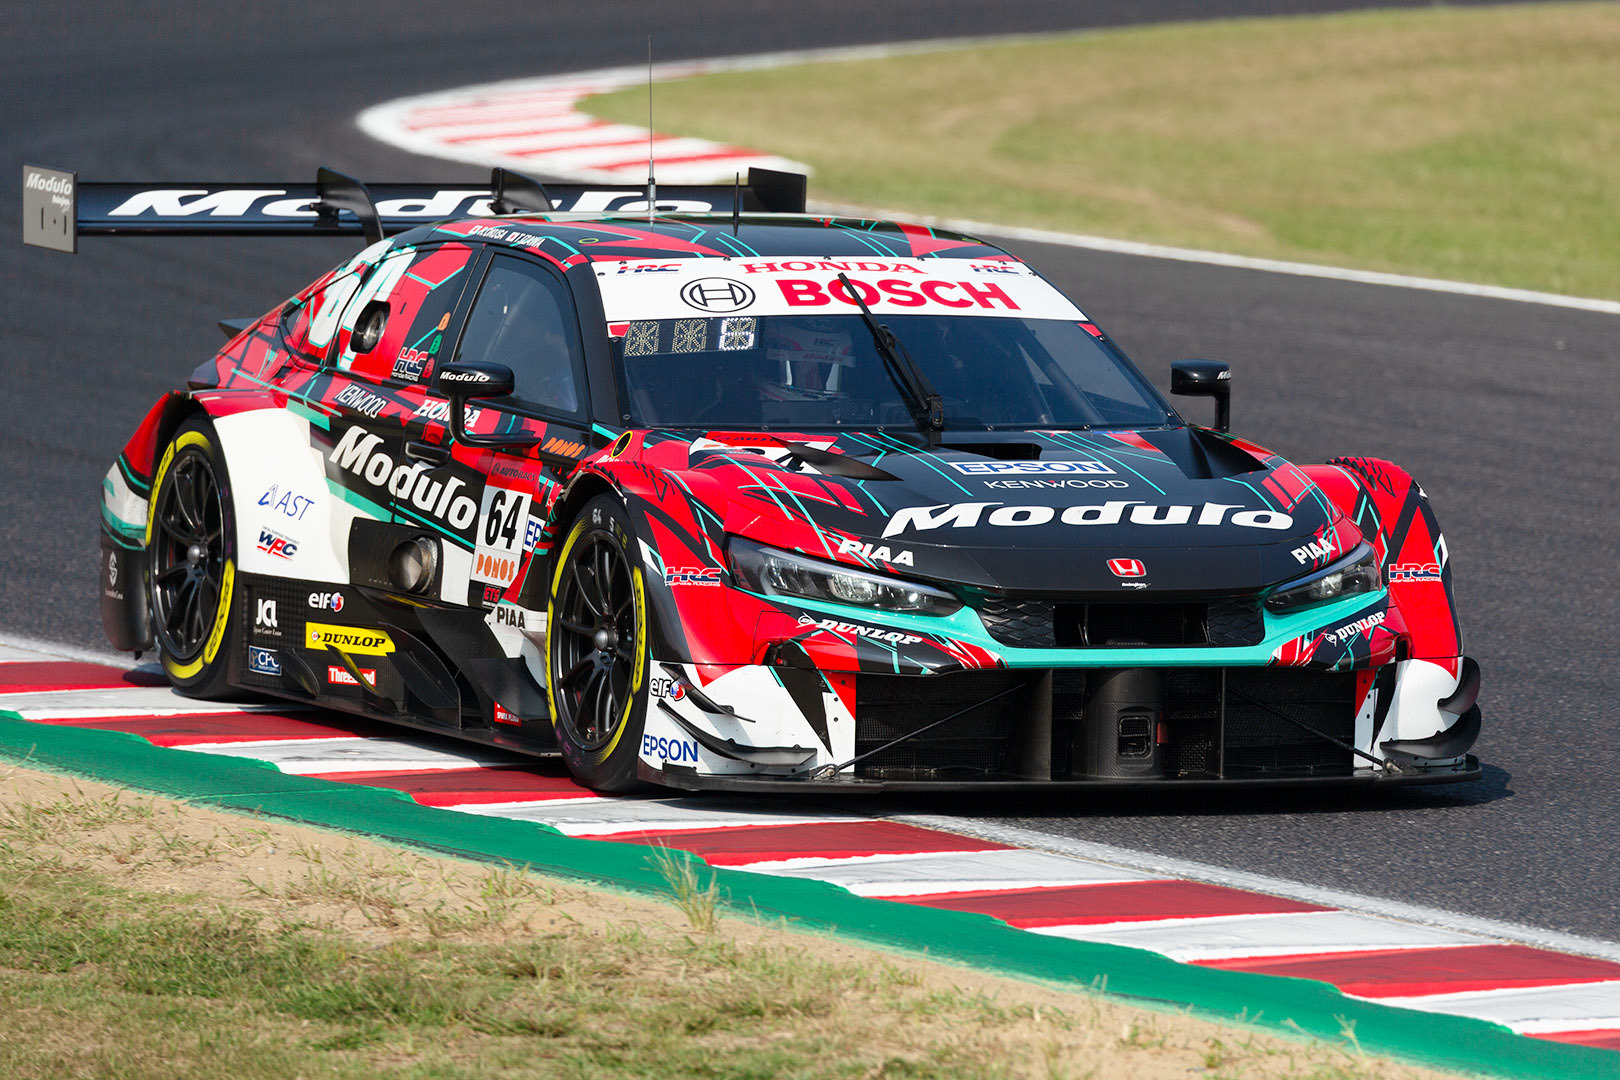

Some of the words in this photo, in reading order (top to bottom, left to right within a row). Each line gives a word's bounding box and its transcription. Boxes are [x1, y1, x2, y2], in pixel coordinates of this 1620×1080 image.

[26, 172, 72, 195] Modulo
[617, 264, 682, 274] HRC
[739, 261, 929, 276] HONDA
[776, 279, 1021, 311] BOSCH
[392, 346, 429, 376] HRC
[440, 371, 490, 383] Modulo
[335, 384, 387, 418] KENWOOD
[541, 437, 585, 458] PONOS
[329, 425, 477, 530] Modulo
[499, 467, 537, 482] AUTOBACS
[960, 461, 1111, 474] EPSON
[983, 479, 1130, 489] KENWOOD
[485, 490, 524, 550] 64
[881, 501, 1294, 539] Modulo
[259, 530, 298, 556] WPC
[837, 538, 915, 566] PIAA
[1291, 537, 1337, 565] PIAA
[476, 554, 515, 582] PONOS
[665, 566, 721, 583] HRC
[1389, 563, 1441, 579] HRC
[308, 592, 331, 609] elf
[484, 587, 500, 602] ETS
[497, 607, 526, 629] PIAA
[1336, 611, 1385, 641] DUNLOP
[322, 632, 386, 648] DUNLOP
[816, 619, 923, 644] DUNLOP
[650, 678, 671, 697] elf
[643, 734, 698, 762] EPSON
